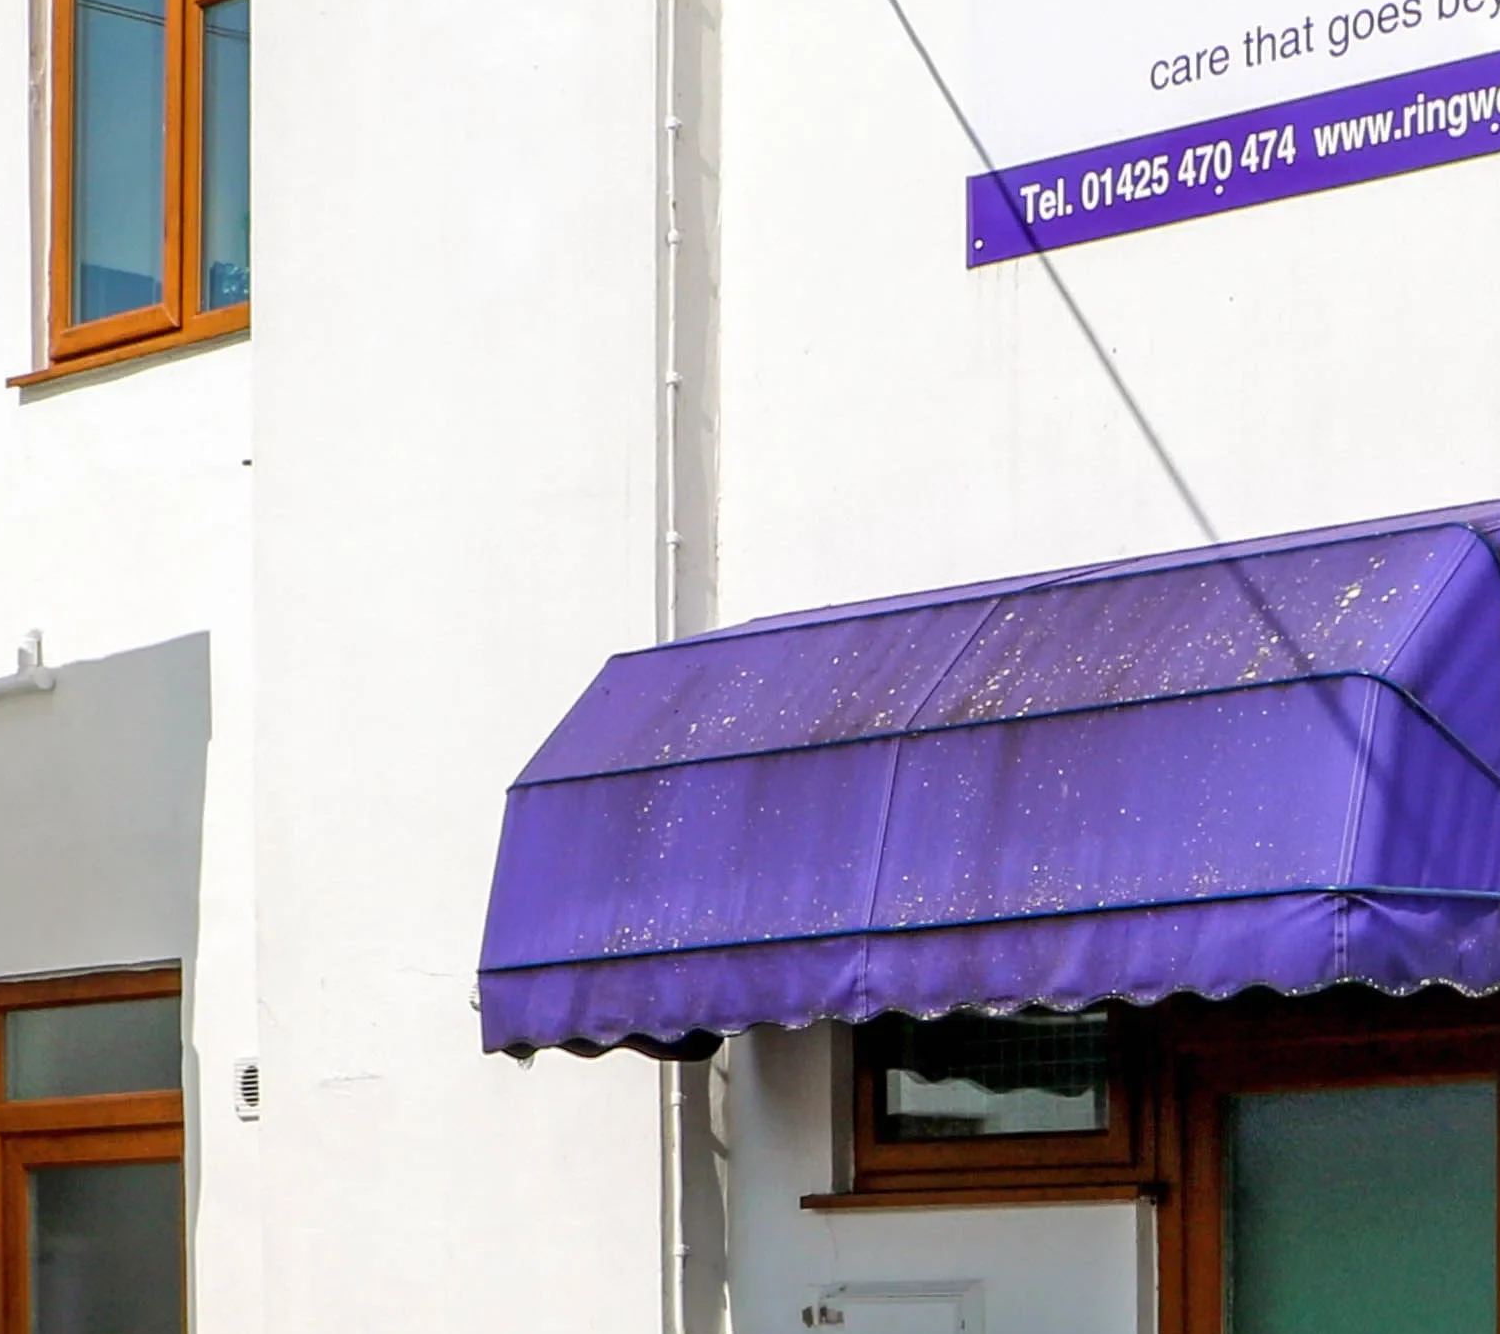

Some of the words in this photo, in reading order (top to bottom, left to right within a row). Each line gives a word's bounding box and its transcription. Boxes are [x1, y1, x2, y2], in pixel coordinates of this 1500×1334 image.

[1150, 47, 1229, 91] care
[1243, 17, 1315, 69] that
[1020, 179, 1073, 225] Tel.
[1081, 161, 1169, 211] 01425
[1177, 143, 1233, 188] 470
[1239, 125, 1297, 173] 474
